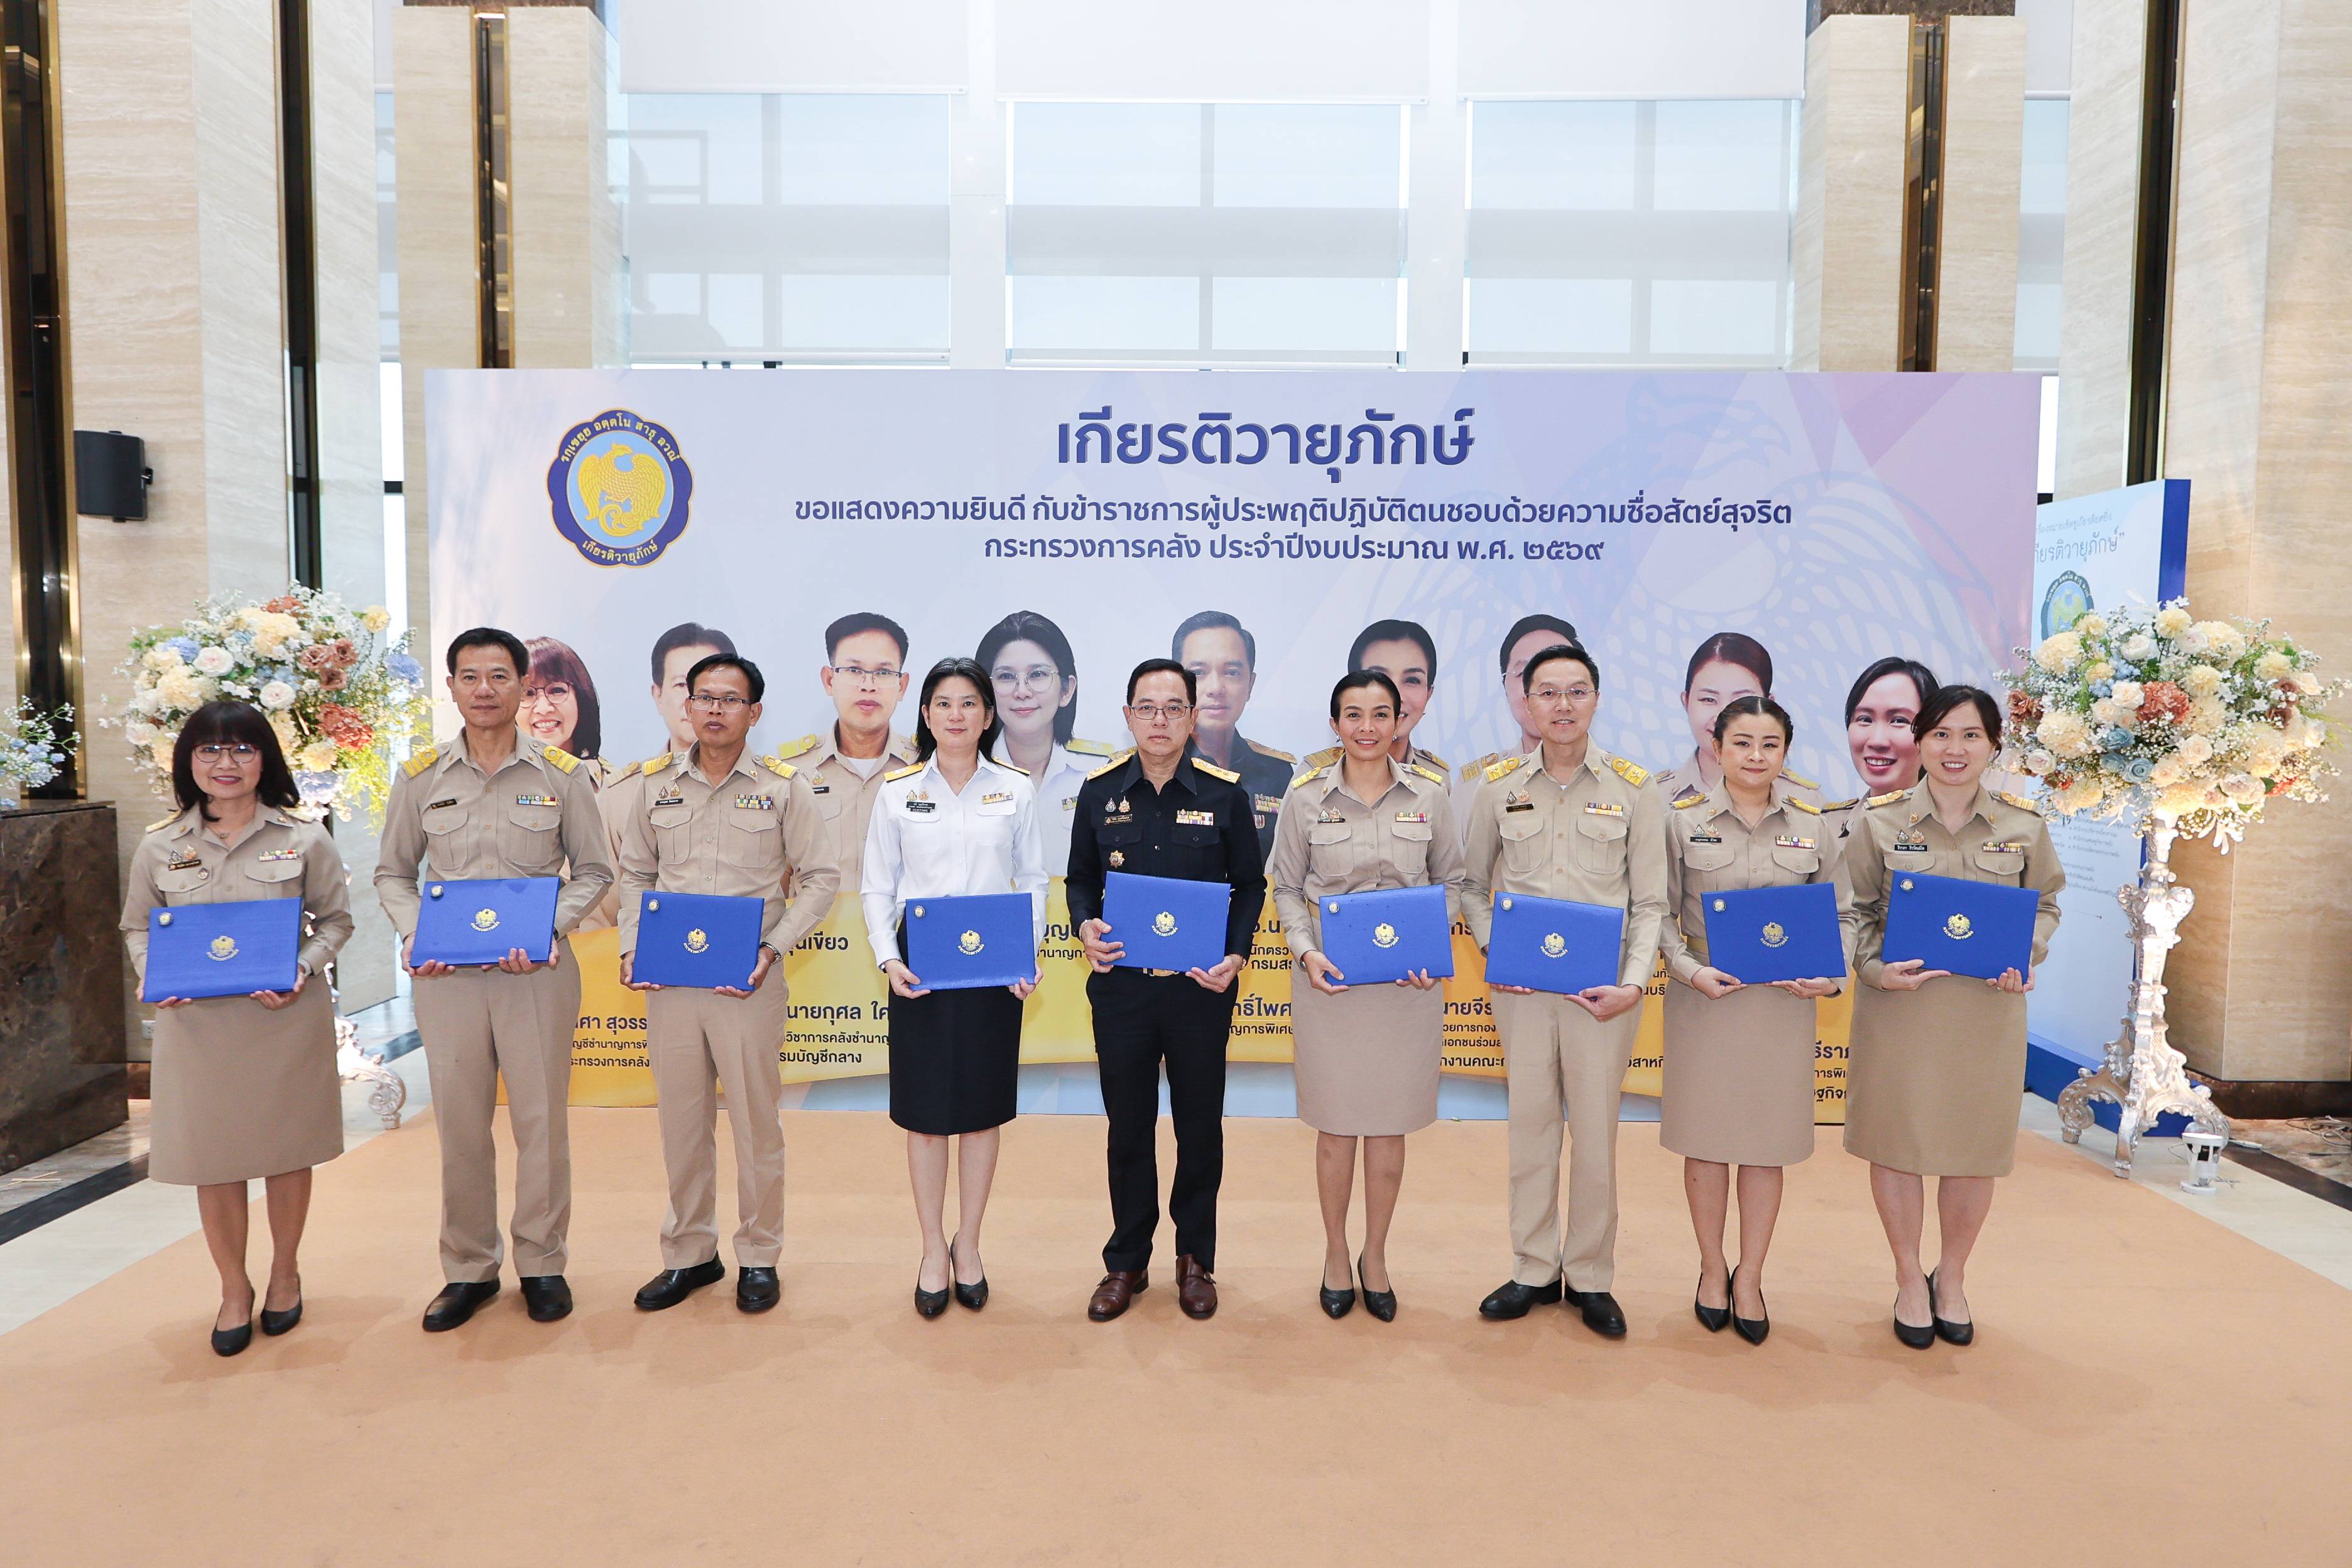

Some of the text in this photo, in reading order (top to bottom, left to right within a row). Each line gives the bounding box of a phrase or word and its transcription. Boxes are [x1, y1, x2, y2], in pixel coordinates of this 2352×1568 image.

[1058, 405, 1475, 484] เกียรติวายุภักษ์
[795, 491, 1792, 531] ขอแสดงความยินดี กับข้าราชการผู้ประพฤติปฏิบัติตนชอบด้วยความซื่อสัตย์สุจริต
[984, 532, 1201, 558] กระทรวงการคลัง
[1210, 531, 1449, 560] ประจำปีงบประมาณ
[1457, 540, 1515, 560] พ.ศ.
[787, 1005, 861, 1025] นายกุศล
